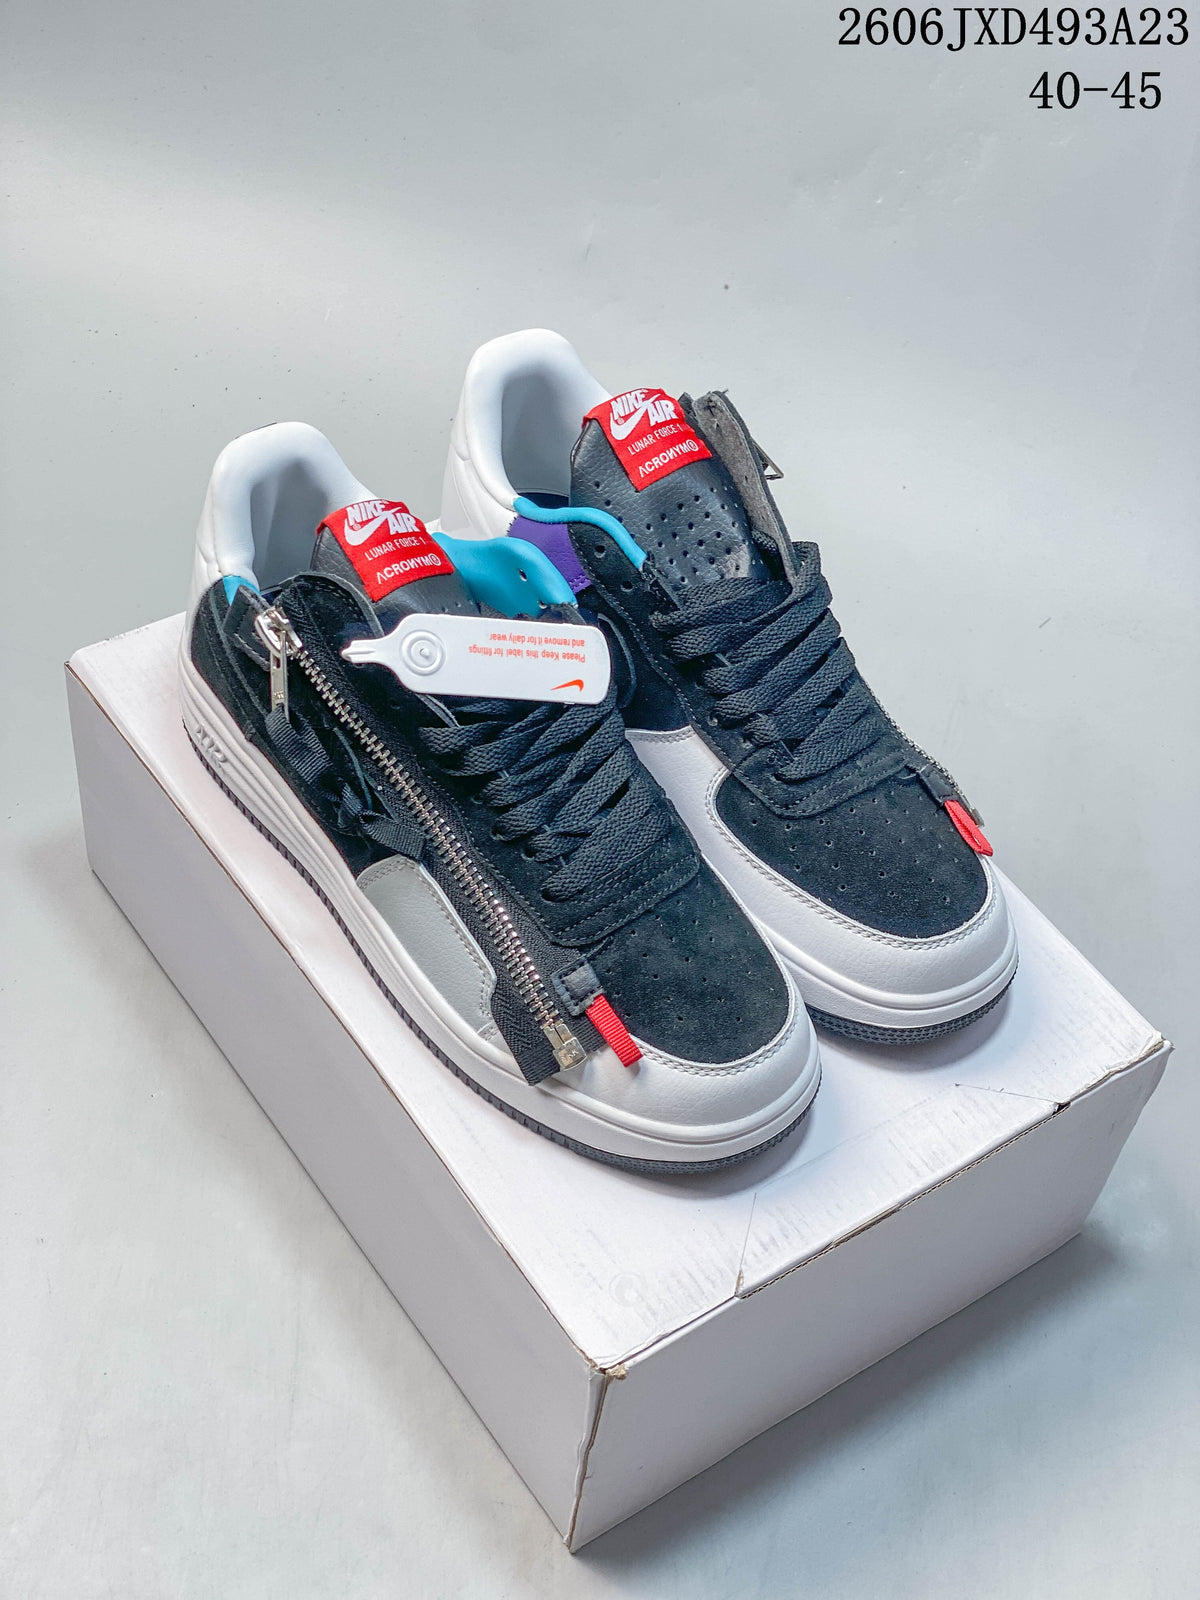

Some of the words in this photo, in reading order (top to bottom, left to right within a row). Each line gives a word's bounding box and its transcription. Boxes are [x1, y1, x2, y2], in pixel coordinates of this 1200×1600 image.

[610, 390, 645, 420] NIKE
[647, 400, 678, 427] AIR
[627, 434, 656, 456] LUNAR
[654, 424, 678, 440] FORCE
[345, 501, 385, 526] NIKE
[387, 512, 420, 535] AIR
[364, 541, 396, 561] LUNAR
[394, 537, 417, 551] FORCE
[489, 633, 507, 641] wear
[508, 632, 525, 644] daily
[526, 636, 537, 646] for
[544, 637, 570, 646] remove
[572, 639, 585, 648] and
[468, 644, 492, 656] fittings
[494, 647, 503, 657] for
[506, 648, 524, 658] label
[526, 649, 539, 658] this
[541, 649, 559, 660] Keep
[562, 652, 586, 663] Please
